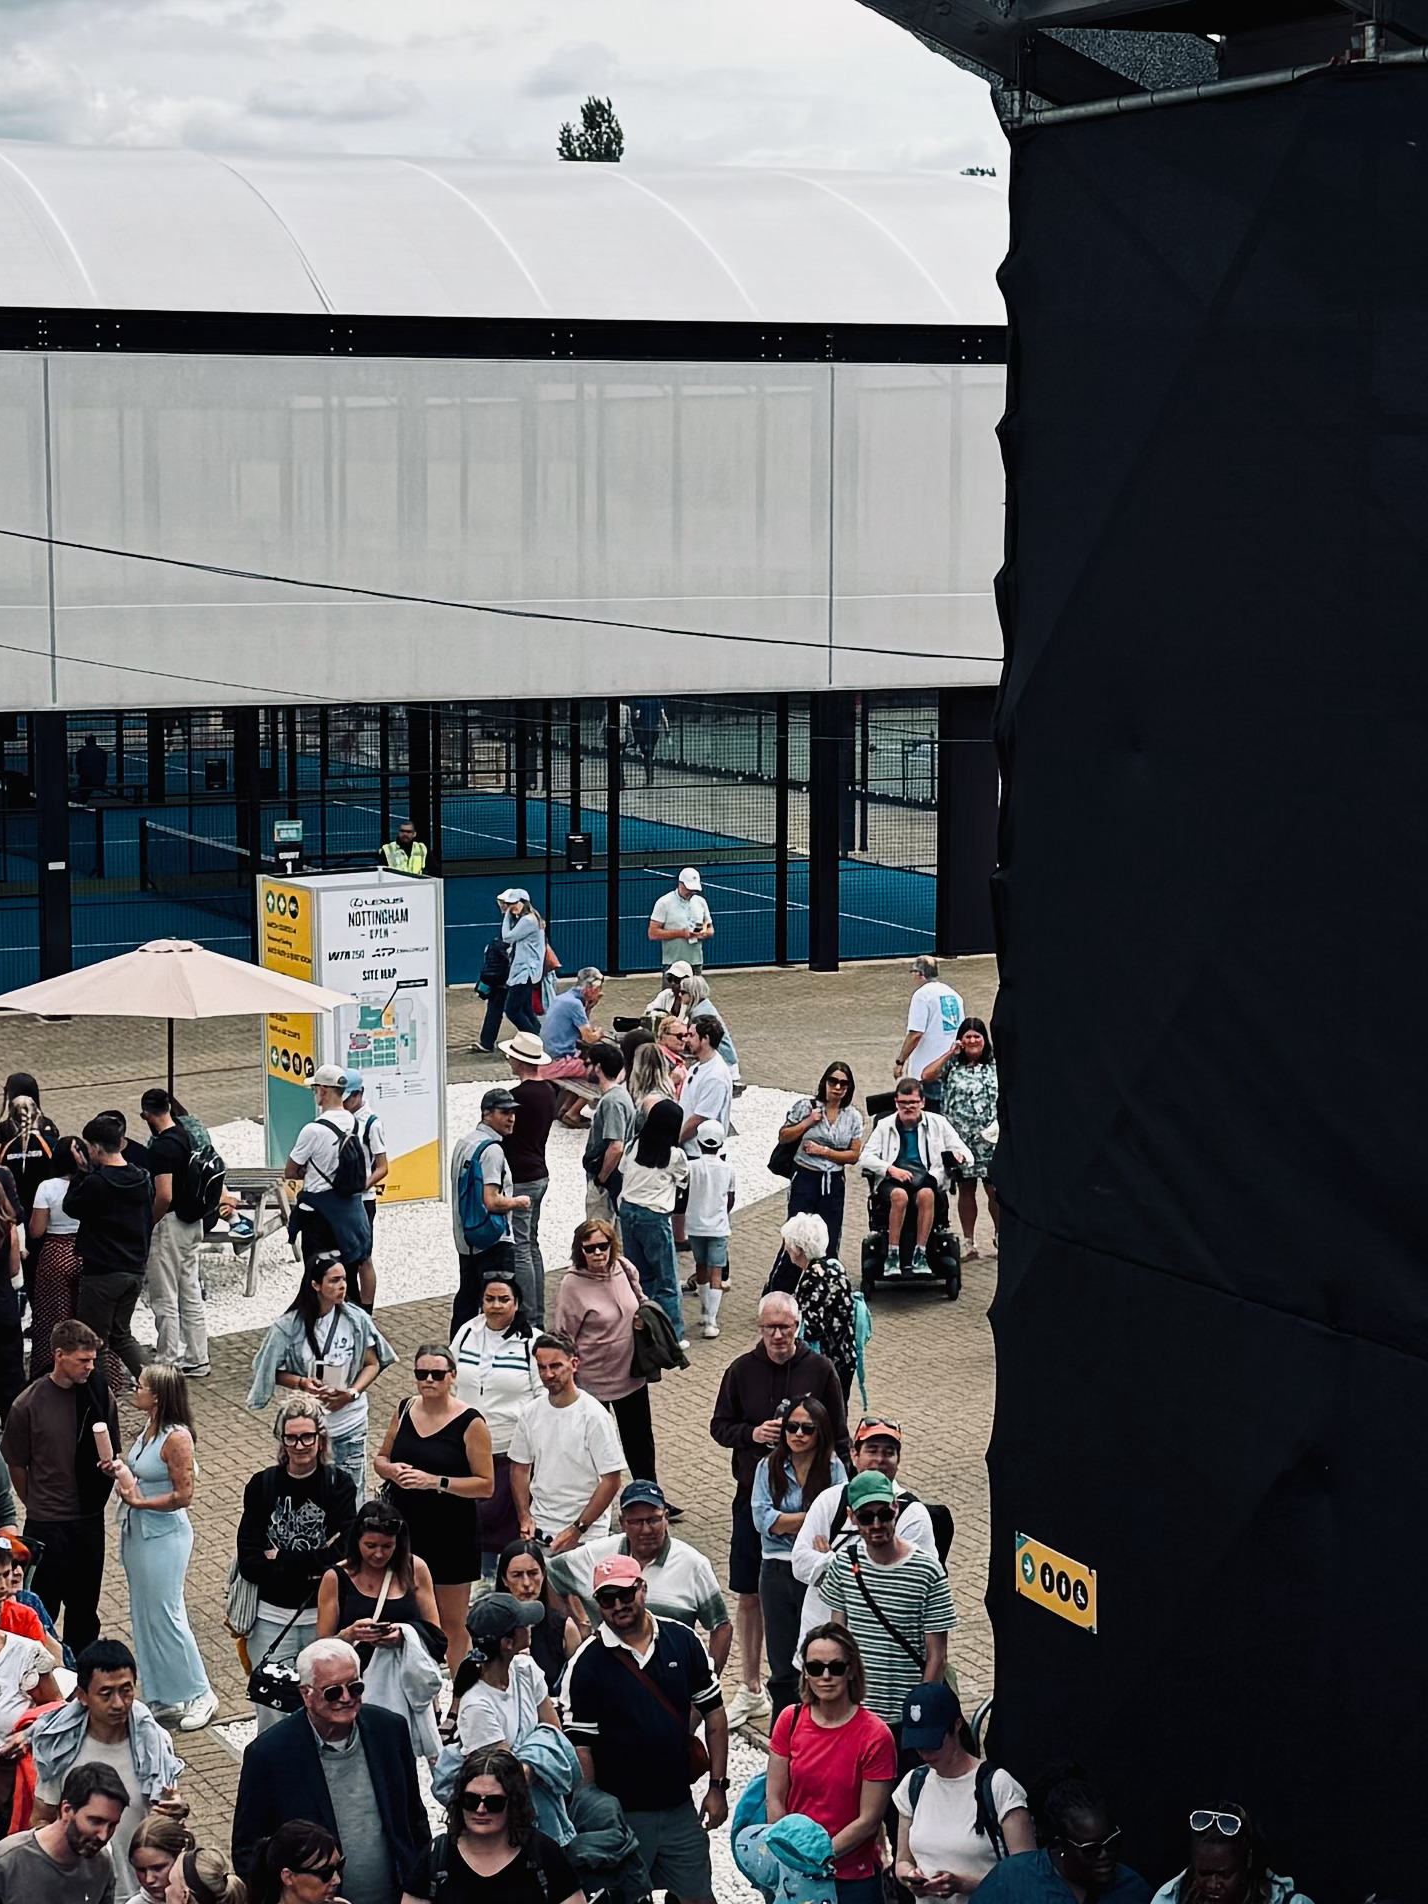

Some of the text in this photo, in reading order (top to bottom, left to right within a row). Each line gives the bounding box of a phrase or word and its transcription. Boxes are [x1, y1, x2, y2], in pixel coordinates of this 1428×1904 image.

[364, 897, 404, 906] LEXUS
[348, 908, 409, 927] NOTTINGHAM
[362, 969, 379, 981] SITE
